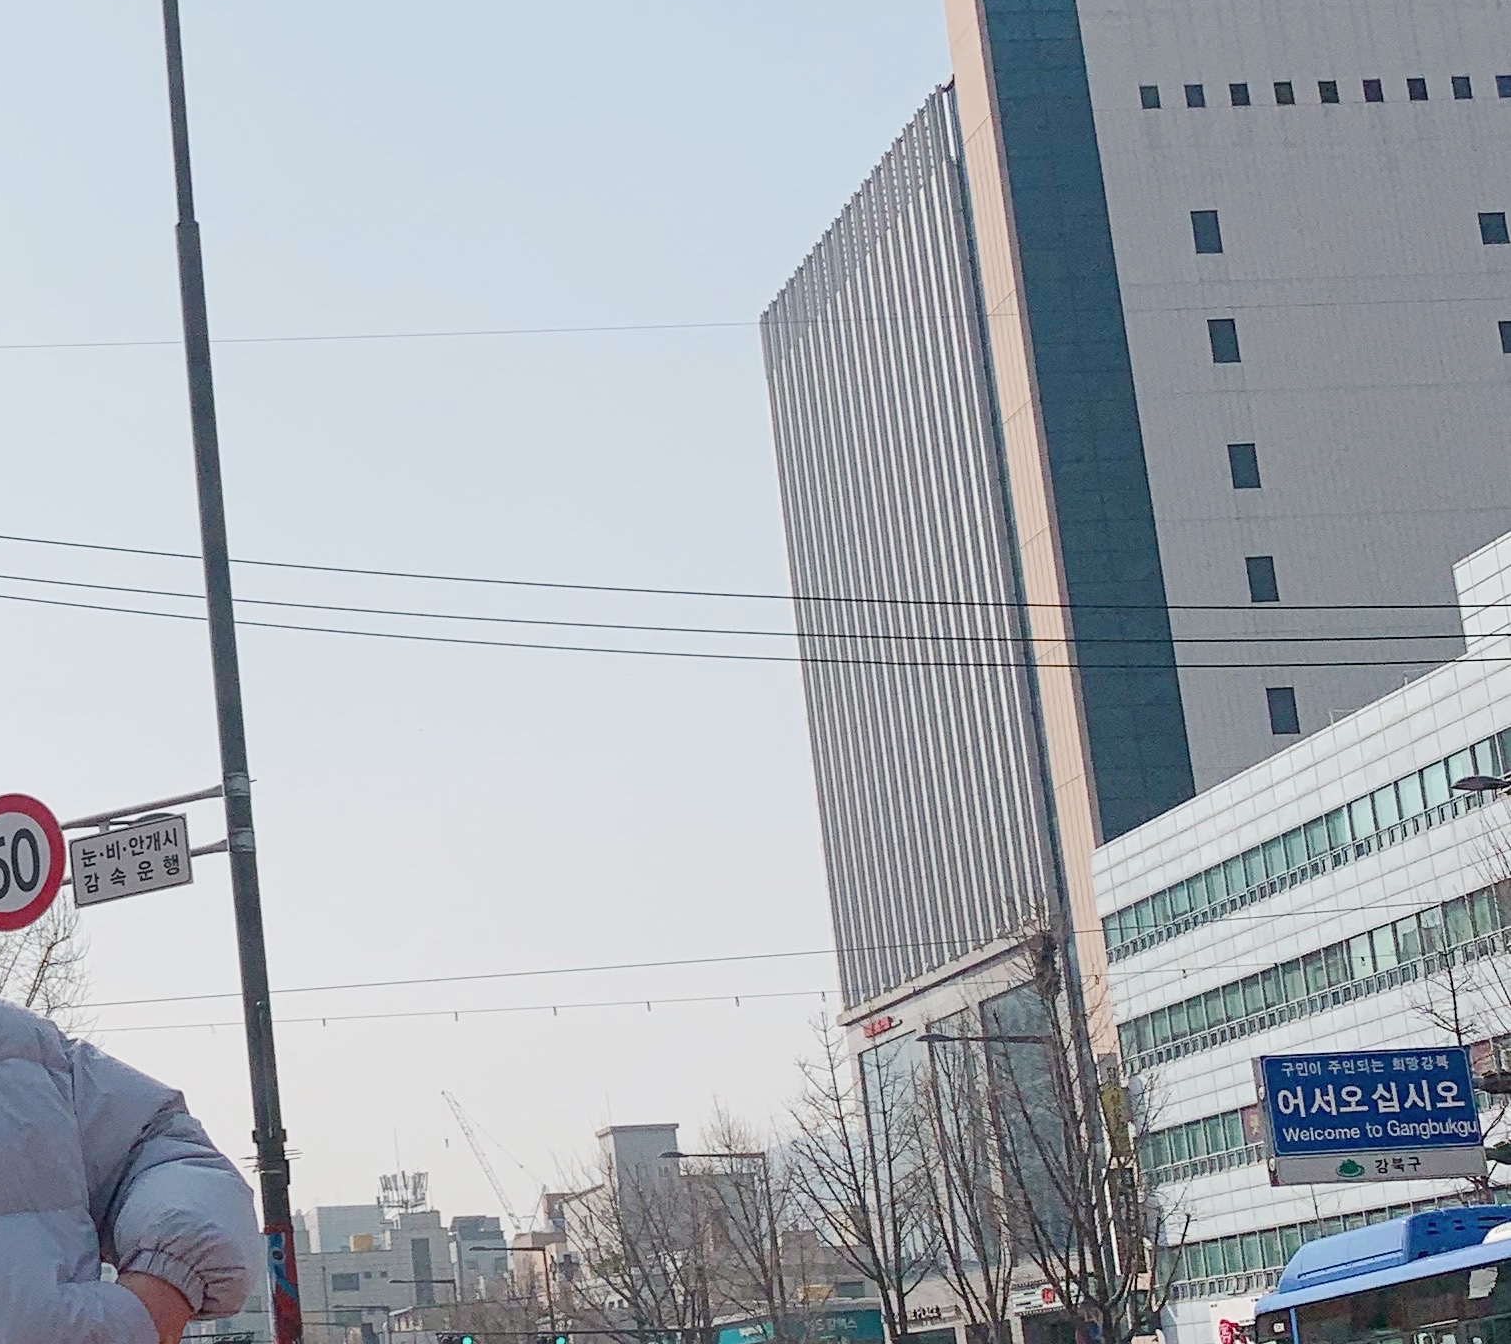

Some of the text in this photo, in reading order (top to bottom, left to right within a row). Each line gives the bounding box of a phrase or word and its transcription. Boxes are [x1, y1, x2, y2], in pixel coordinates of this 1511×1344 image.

[1280, 1053, 1450, 1078] 구민이 주인되는 희망강북
[1277, 1079, 1467, 1118] 어서오십시오
[1282, 1122, 1361, 1143] Welcome
[1365, 1122, 1384, 1139] to
[1386, 1117, 1479, 1141] Gangbukgu
[1374, 1155, 1422, 1175] 강북구
